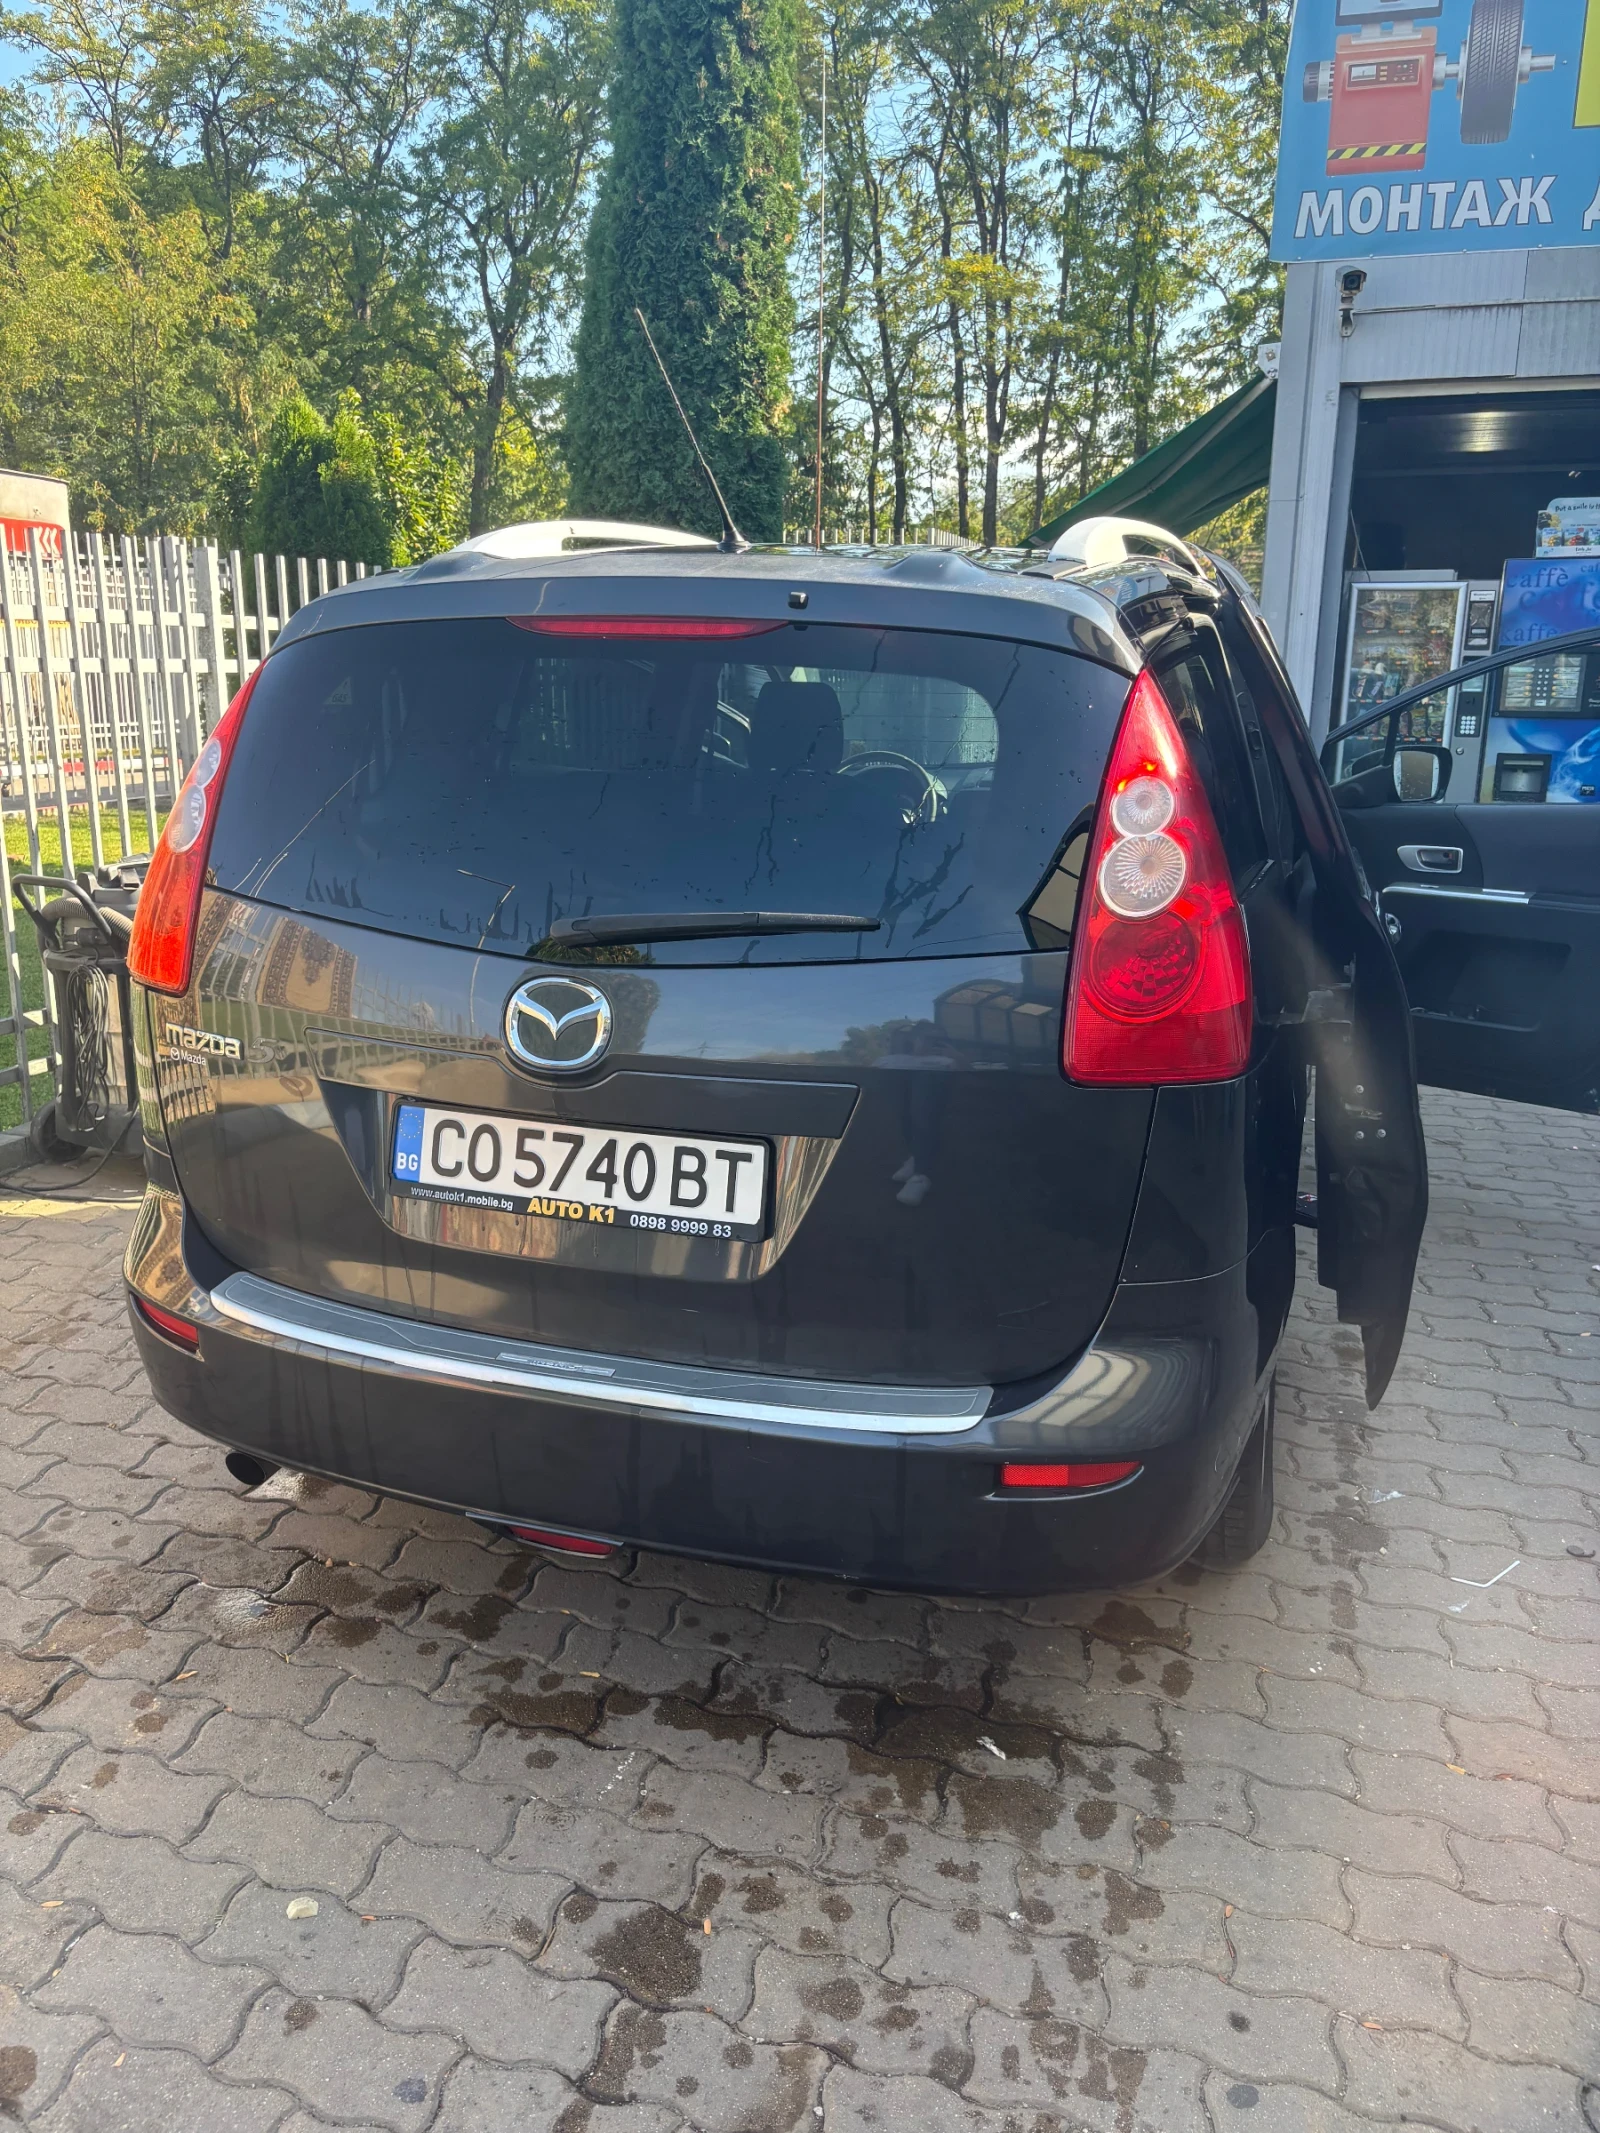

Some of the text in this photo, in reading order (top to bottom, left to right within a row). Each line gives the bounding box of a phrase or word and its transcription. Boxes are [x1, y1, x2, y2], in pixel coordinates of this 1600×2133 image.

[1293, 174, 1559, 239] МОНТАЖ
[1505, 567, 1569, 588] caffè
[181, 1049, 207, 1066] Mazda
[248, 1037, 275, 1064] 5
[396, 1152, 419, 1172] BG
[410, 1186, 732, 1239] www.autok1.mobile.bg AUTO K1 0898 9999 83
